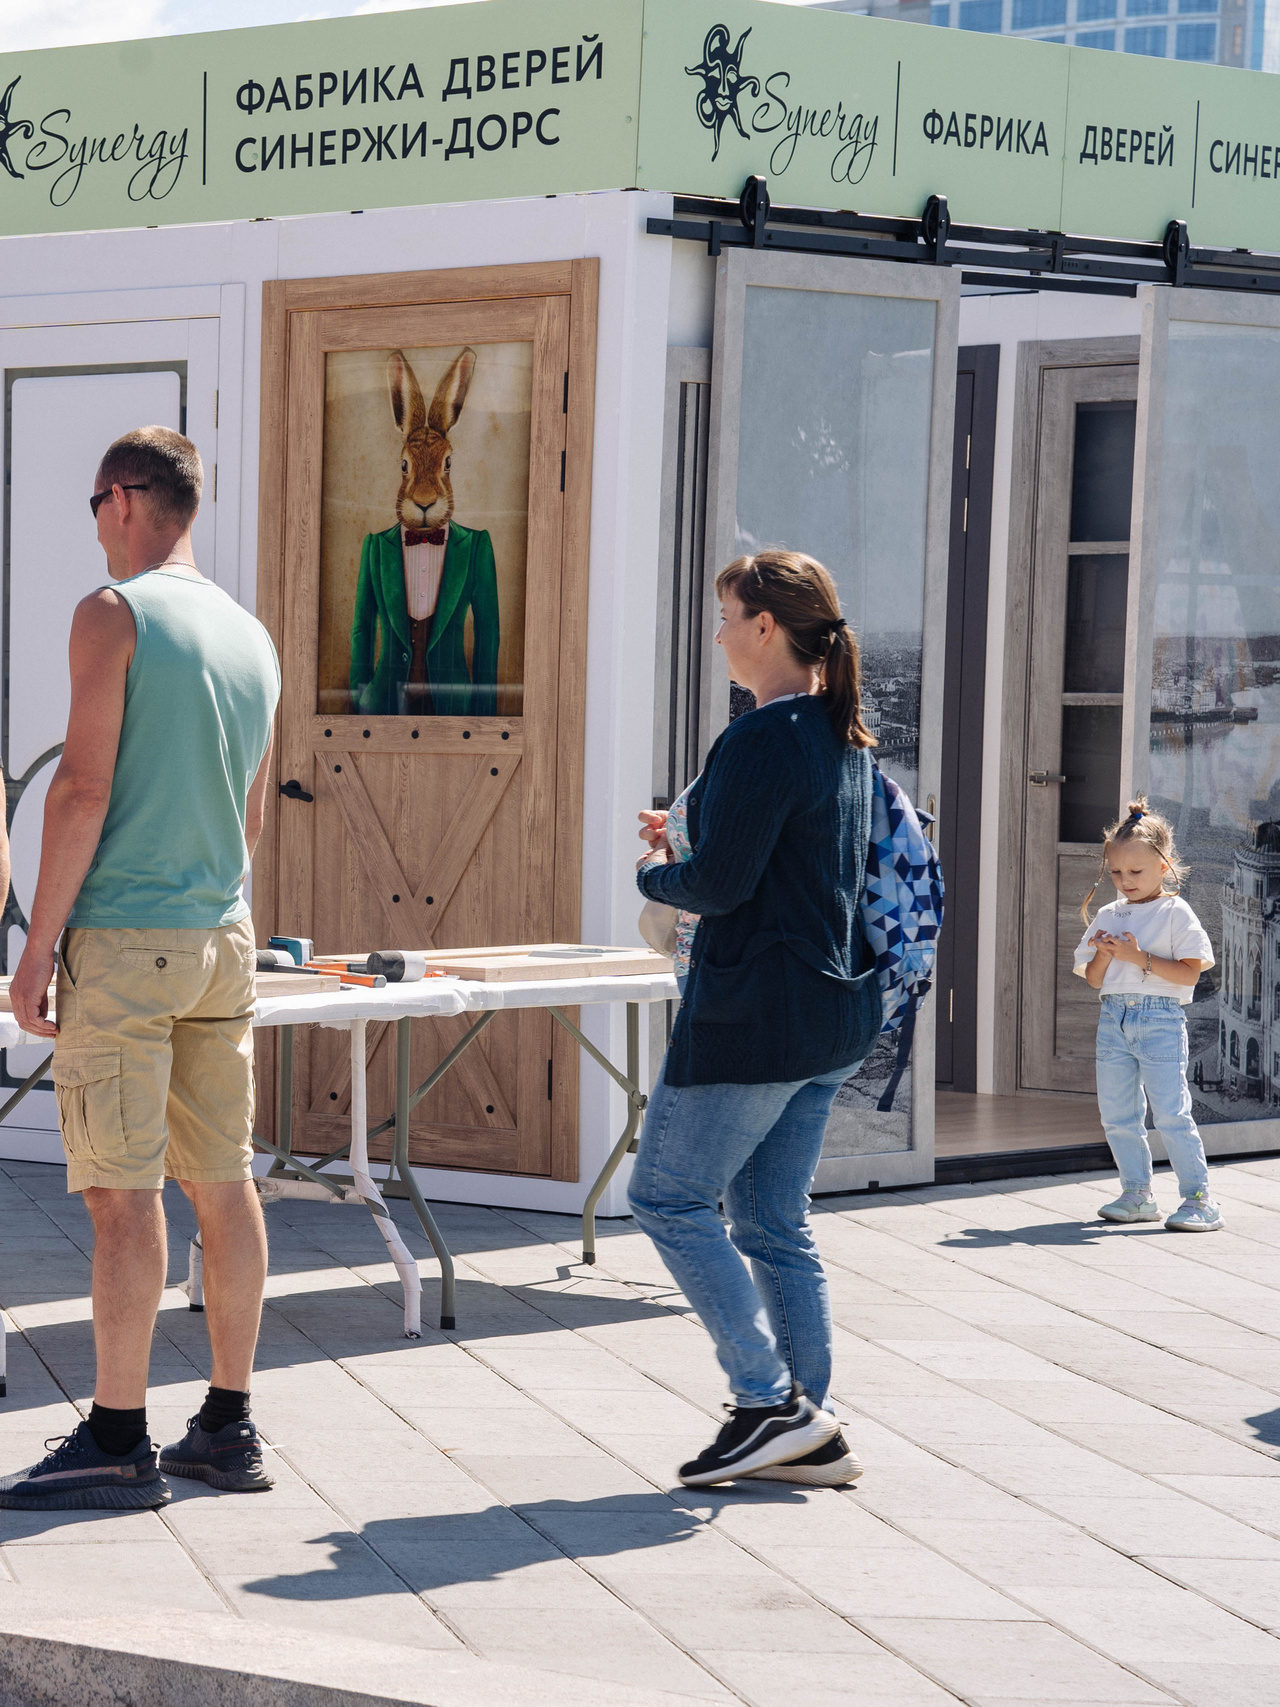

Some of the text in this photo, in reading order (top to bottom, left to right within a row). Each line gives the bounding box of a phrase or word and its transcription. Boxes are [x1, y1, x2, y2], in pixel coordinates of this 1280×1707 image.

[236, 33, 603, 116] ФАБРИКА ДВЕРЕЙ
[25, 108, 189, 206] Synergy
[235, 107, 561, 173] СИНЕРЖИ-ДОРС
[751, 71, 879, 185] Synergy
[922, 108, 1049, 157] ФАБРИКА
[1079, 124, 1174, 167] ДВЕРЕЙ
